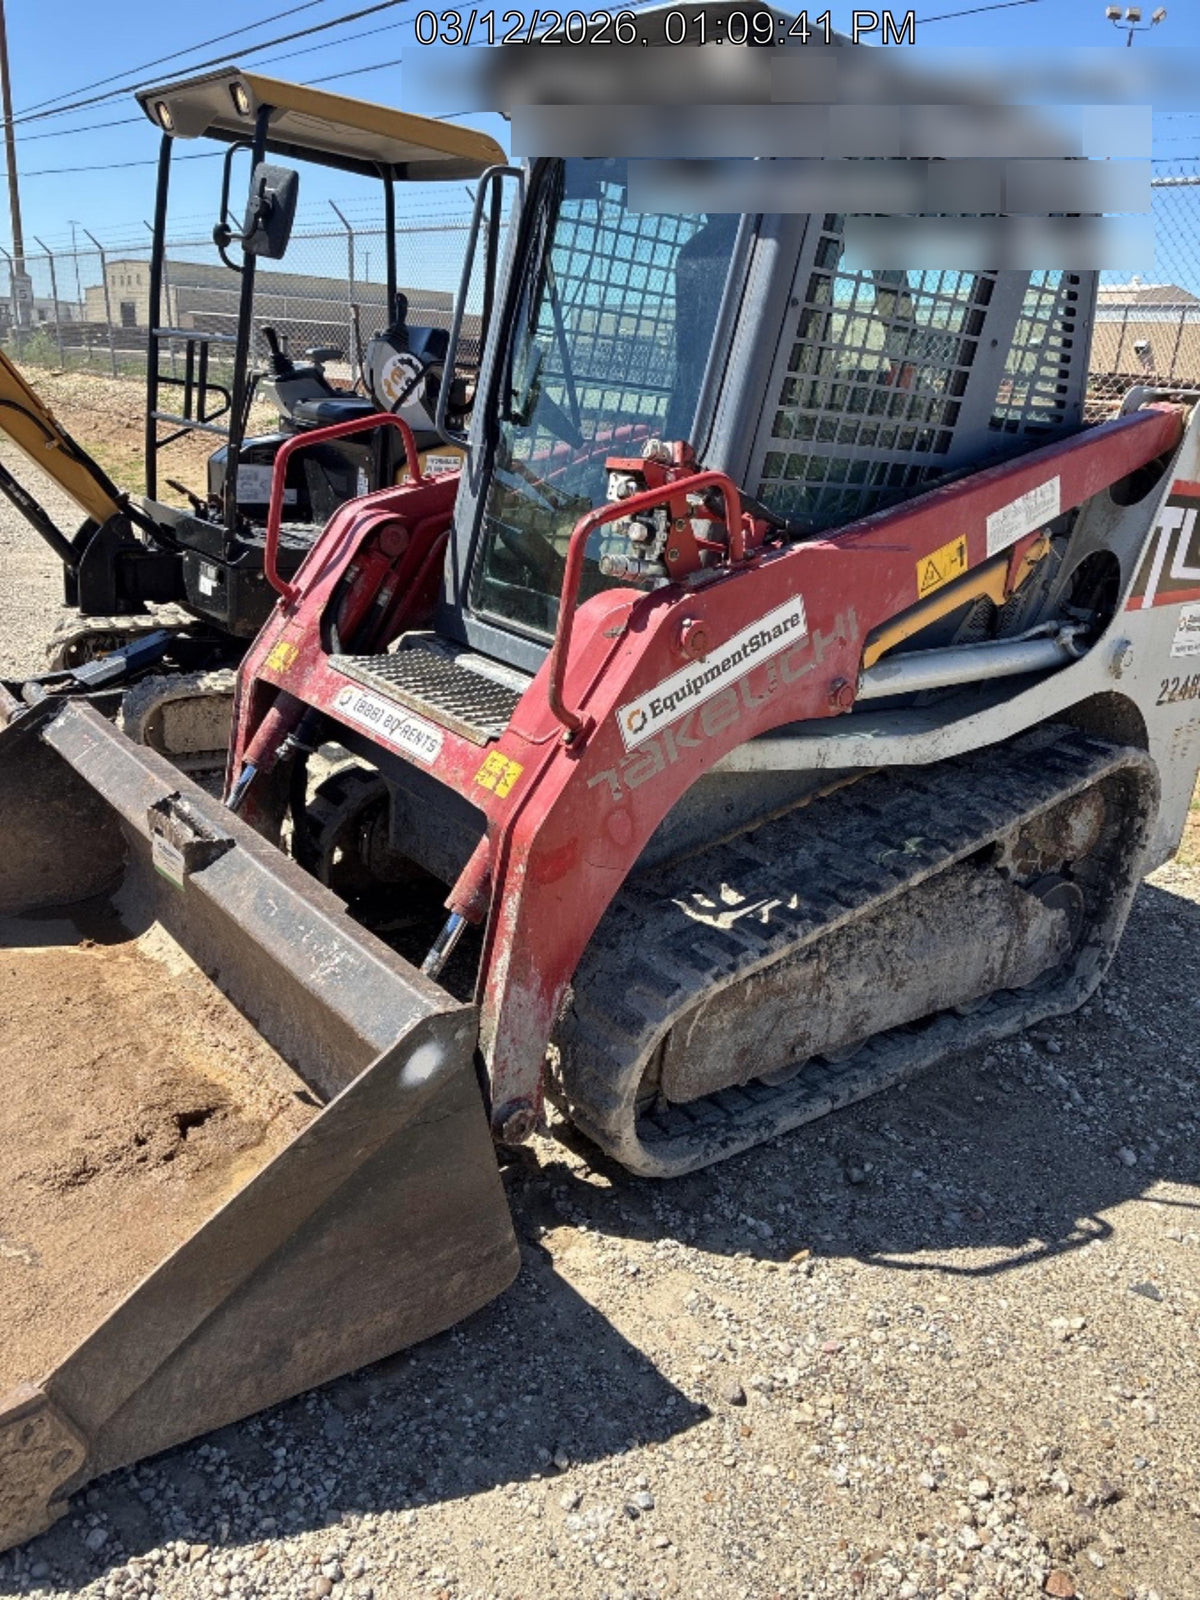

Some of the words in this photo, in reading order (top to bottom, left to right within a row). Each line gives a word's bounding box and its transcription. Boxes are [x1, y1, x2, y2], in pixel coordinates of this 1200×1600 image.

[648, 611, 801, 720] EquipmentShare
[1156, 673, 1200, 706] 2248
[353, 698, 385, 724] (888)
